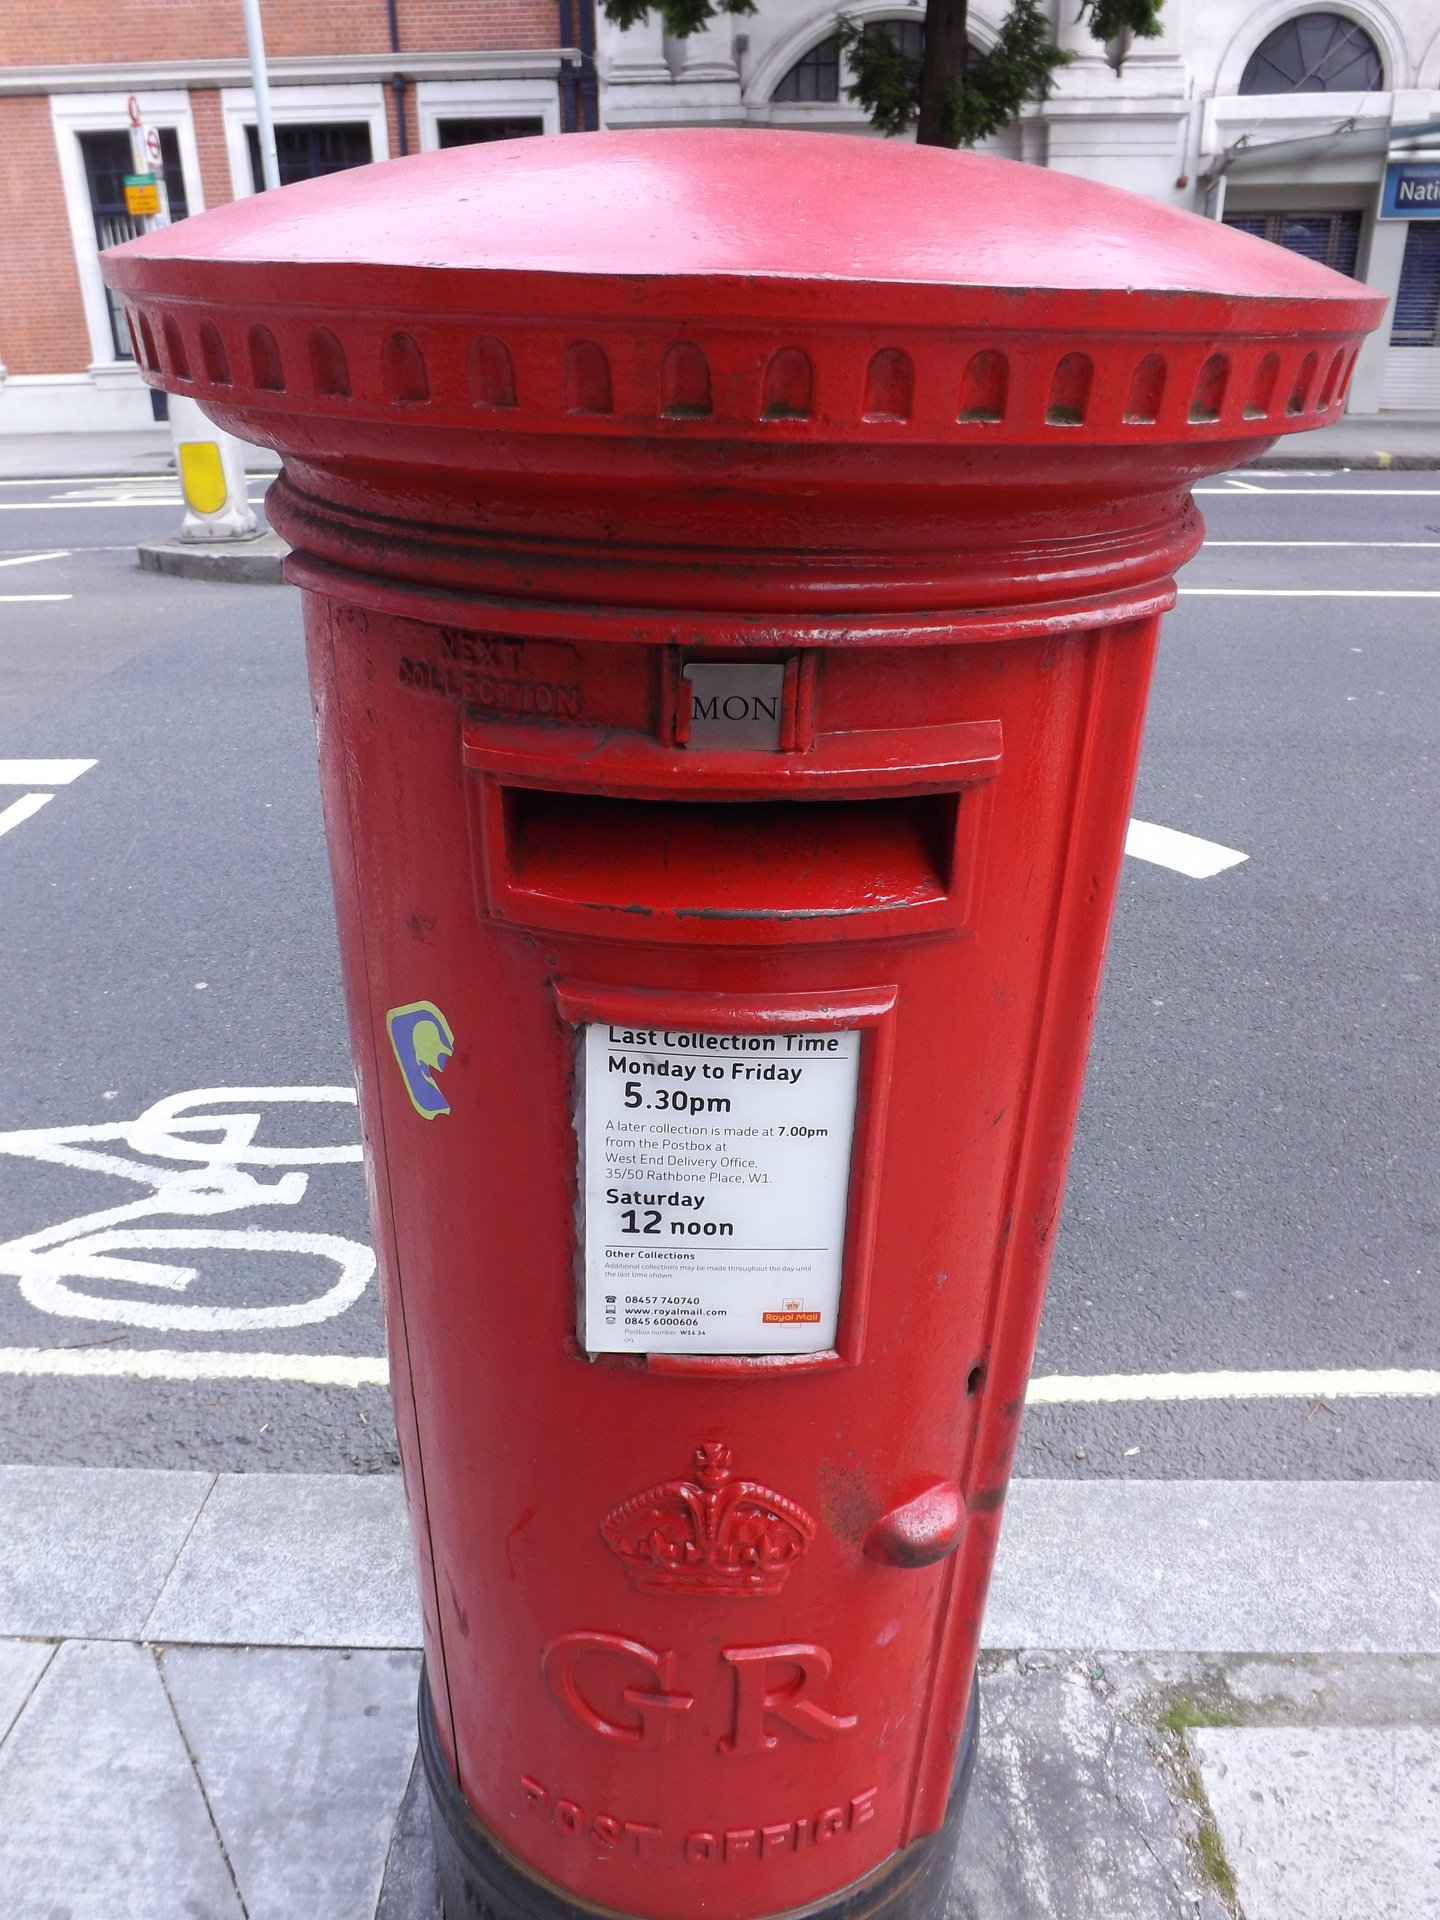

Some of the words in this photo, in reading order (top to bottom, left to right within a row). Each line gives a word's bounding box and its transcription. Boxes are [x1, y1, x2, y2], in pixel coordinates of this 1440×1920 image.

[1400, 180, 1440, 200] Nati
[439, 628, 524, 669] NEXT
[398, 655, 582, 720] COLLECTION
[692, 695, 779, 720] MON
[609, 1026, 657, 1046] Last
[664, 1032, 775, 1051] Collection
[783, 1034, 839, 1051] Time
[608, 1055, 697, 1082] Monday
[702, 1063, 725, 1079] to
[732, 1063, 803, 1084] Friday
[624, 1081, 731, 1116] 5.30pm
[605, 1120, 615, 1131] A
[617, 1121, 646, 1132] later
[649, 1124, 708, 1135] collection
[711, 1125, 721, 1136] is
[724, 1127, 759, 1136] made
[762, 1127, 775, 1137] at
[778, 1126, 828, 1139] 7.00pm
[605, 1136, 636, 1147] from
[639, 1138, 659, 1149] the
[662, 1139, 712, 1151] Postbox
[715, 1142, 728, 1152] at
[605, 1152, 637, 1164] West
[640, 1154, 664, 1165] End
[667, 1155, 718, 1169] Delivery
[605, 1168, 644, 1180] 35/50
[647, 1170, 706, 1182] Rathbone
[748, 1173, 773, 1184] W1.
[606, 1188, 705, 1210] Saturday
[620, 1210, 662, 1234] 12
[670, 1222, 734, 1236] noon
[605, 1250, 635, 1259] Other
[638, 1251, 696, 1260] Collections
[680, 1264, 695, 1272] may
[728, 1265, 768, 1273] throughout
[782, 1265, 795, 1273] day
[625, 1296, 658, 1304] 08457
[660, 1297, 700, 1305] 740740
[625, 1308, 727, 1317] www.royalmail.com
[625, 1317, 651, 1325] 0845
[653, 1318, 699, 1326] 6000606
[765, 1313, 793, 1322] Royal
[521, 1774, 663, 1857] POST
[684, 1786, 878, 1865] OFFICE
